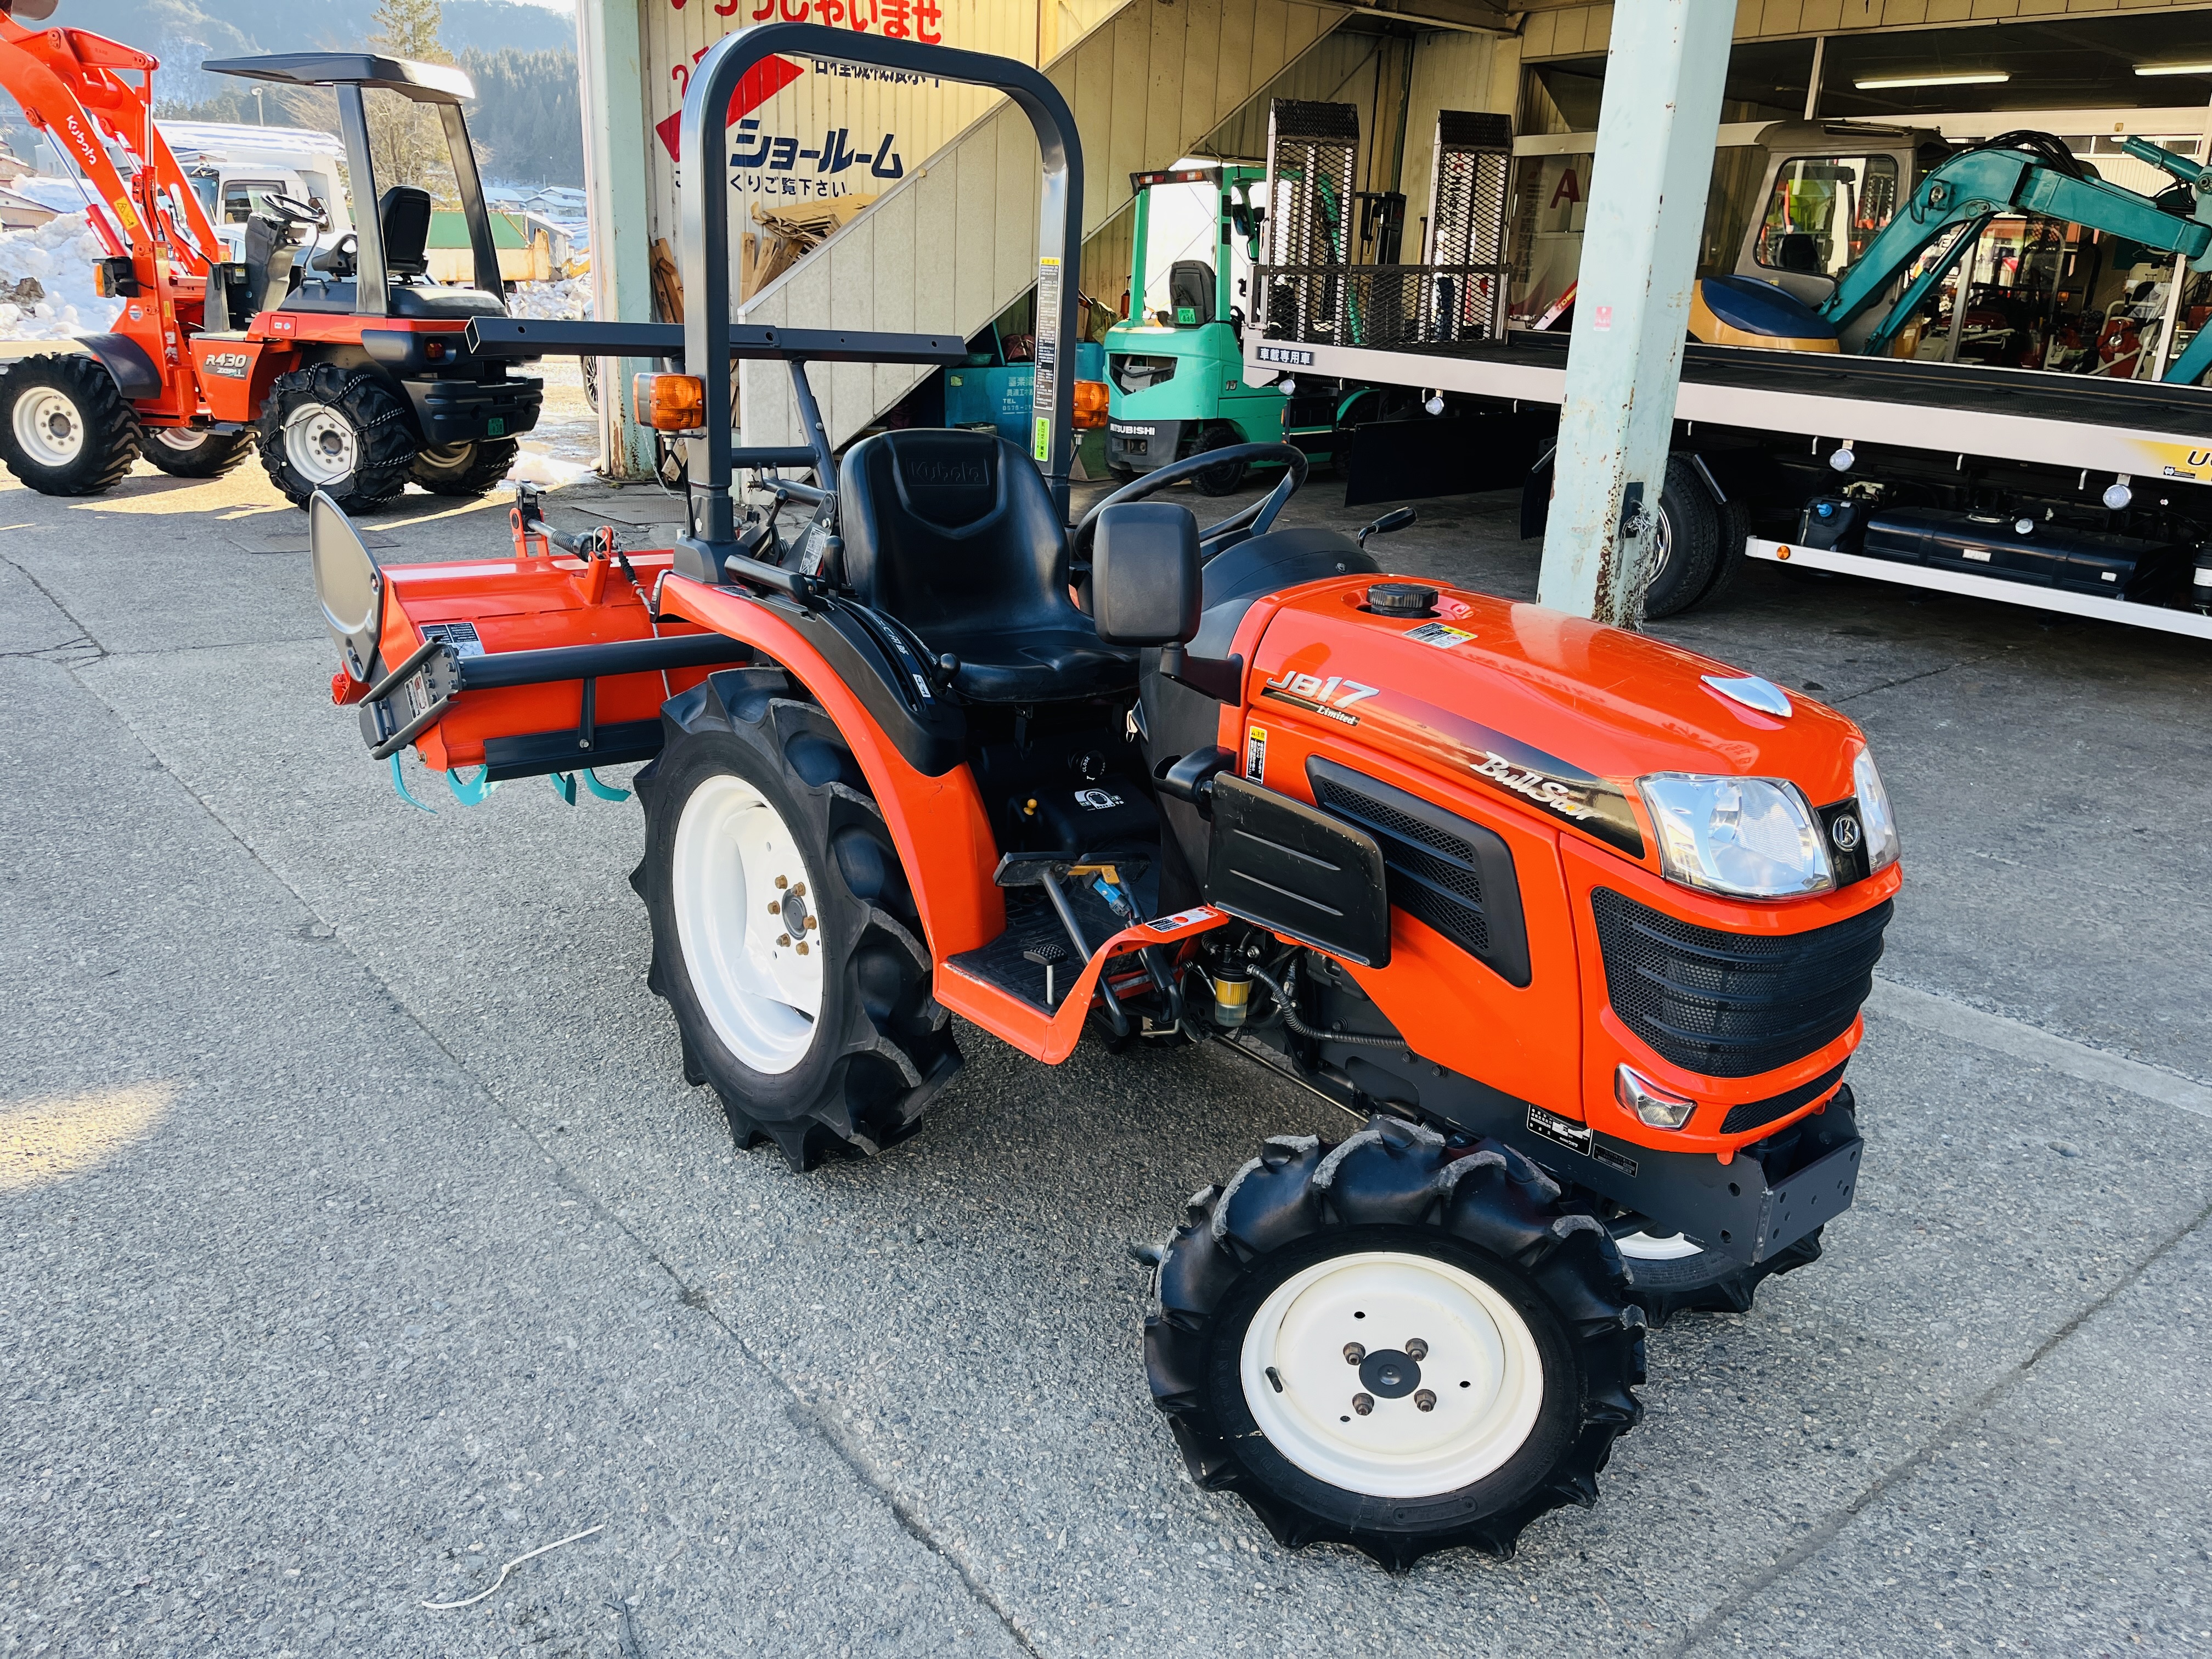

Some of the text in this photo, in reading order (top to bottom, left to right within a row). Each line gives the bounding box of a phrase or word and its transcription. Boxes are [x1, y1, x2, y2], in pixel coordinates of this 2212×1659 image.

[670, 0, 941, 44] っしゃいませ
[66, 115, 97, 165] Kubota
[730, 119, 904, 179] ショールーム
[206, 353, 247, 368] R430
[1260, 348, 1311, 365] 車載専用車
[2186, 449, 2212, 467] U
[1266, 670, 1380, 709] JB17
[1317, 705, 1357, 725] Limited
[1082, 756, 1091, 772] CLOSE
